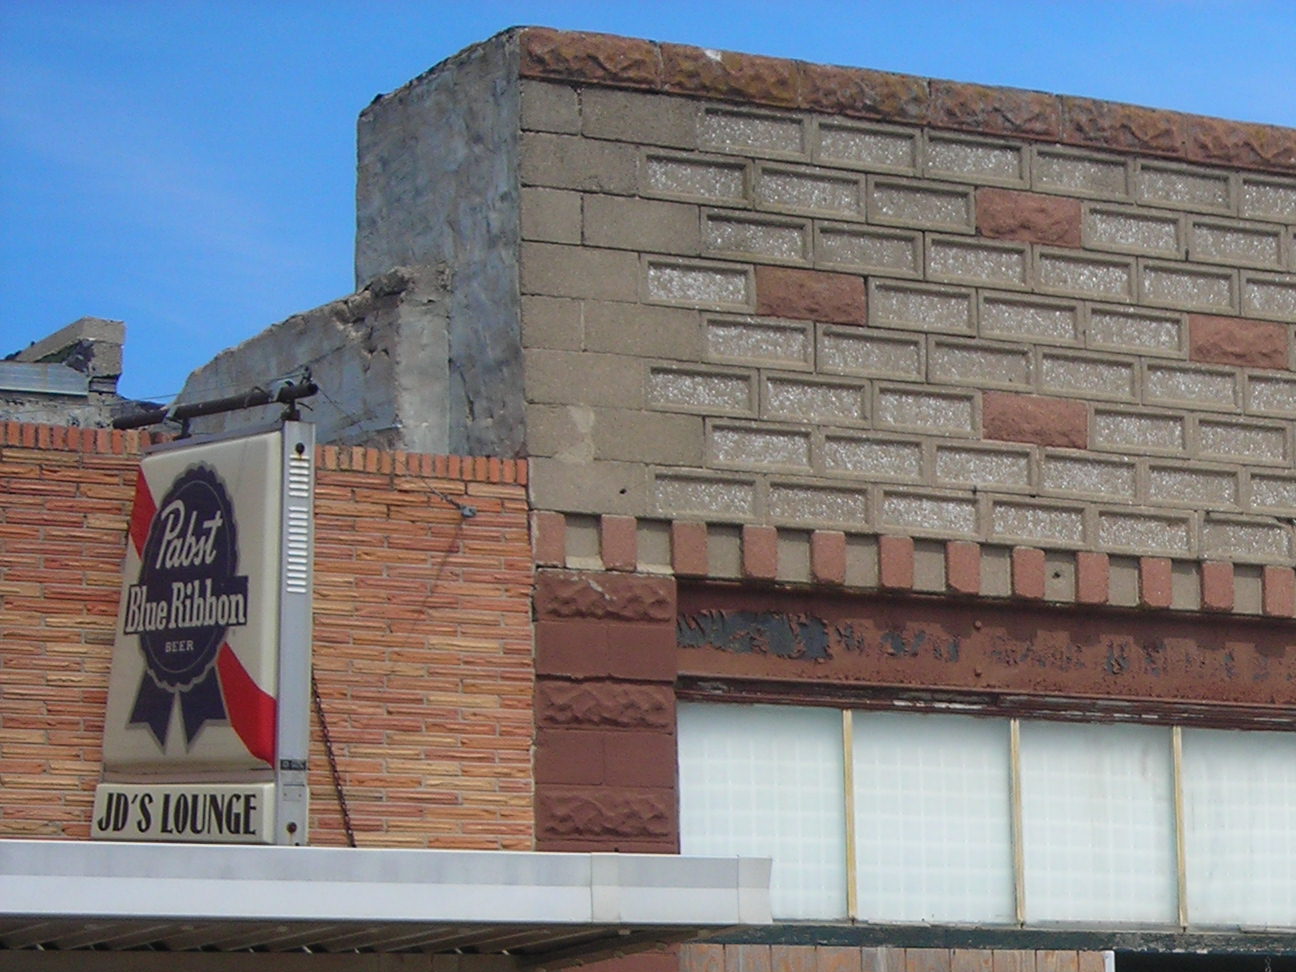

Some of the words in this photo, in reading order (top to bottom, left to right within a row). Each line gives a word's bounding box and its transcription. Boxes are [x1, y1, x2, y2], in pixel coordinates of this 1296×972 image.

[155, 499, 223, 570] Pabst
[125, 585, 168, 633] Blue
[168, 578, 246, 628] Ribbon
[165, 638, 195, 653] BEER
[98, 792, 154, 834] JD'S
[160, 793, 257, 835] LOUNGE
